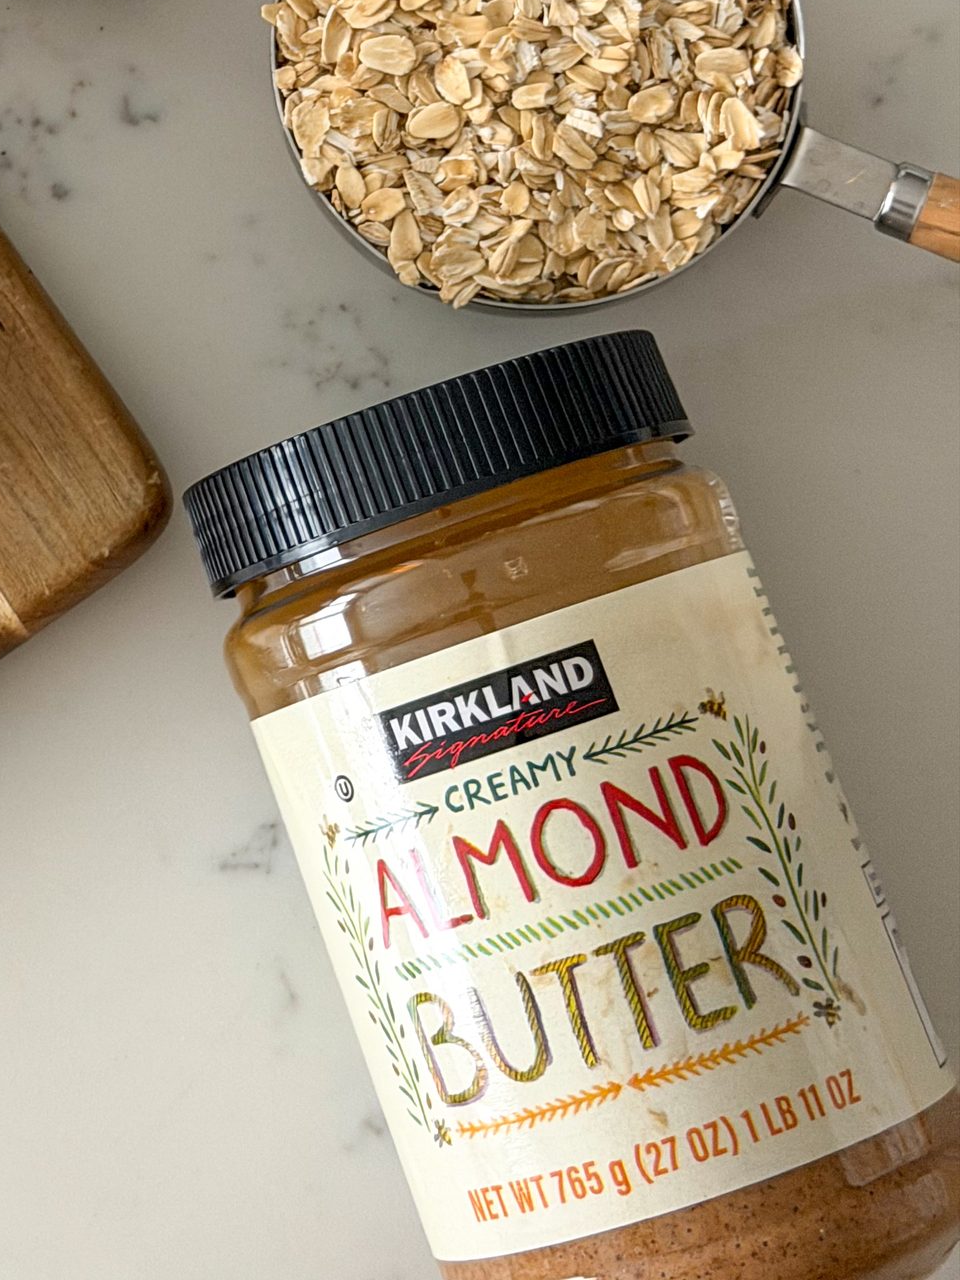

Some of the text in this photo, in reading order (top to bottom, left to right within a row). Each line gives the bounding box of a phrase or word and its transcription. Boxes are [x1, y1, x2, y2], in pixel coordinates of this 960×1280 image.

[388, 655, 594, 751] KIRKLAND
[403, 697, 608, 780] Signature
[444, 745, 578, 814] CREAMY
[376, 753, 730, 950] ALMOND
[407, 893, 801, 1108] BUTTER
[467, 1068, 862, 1223] NET WT 765 g (27 OZ) 1 LB 11 OZ
